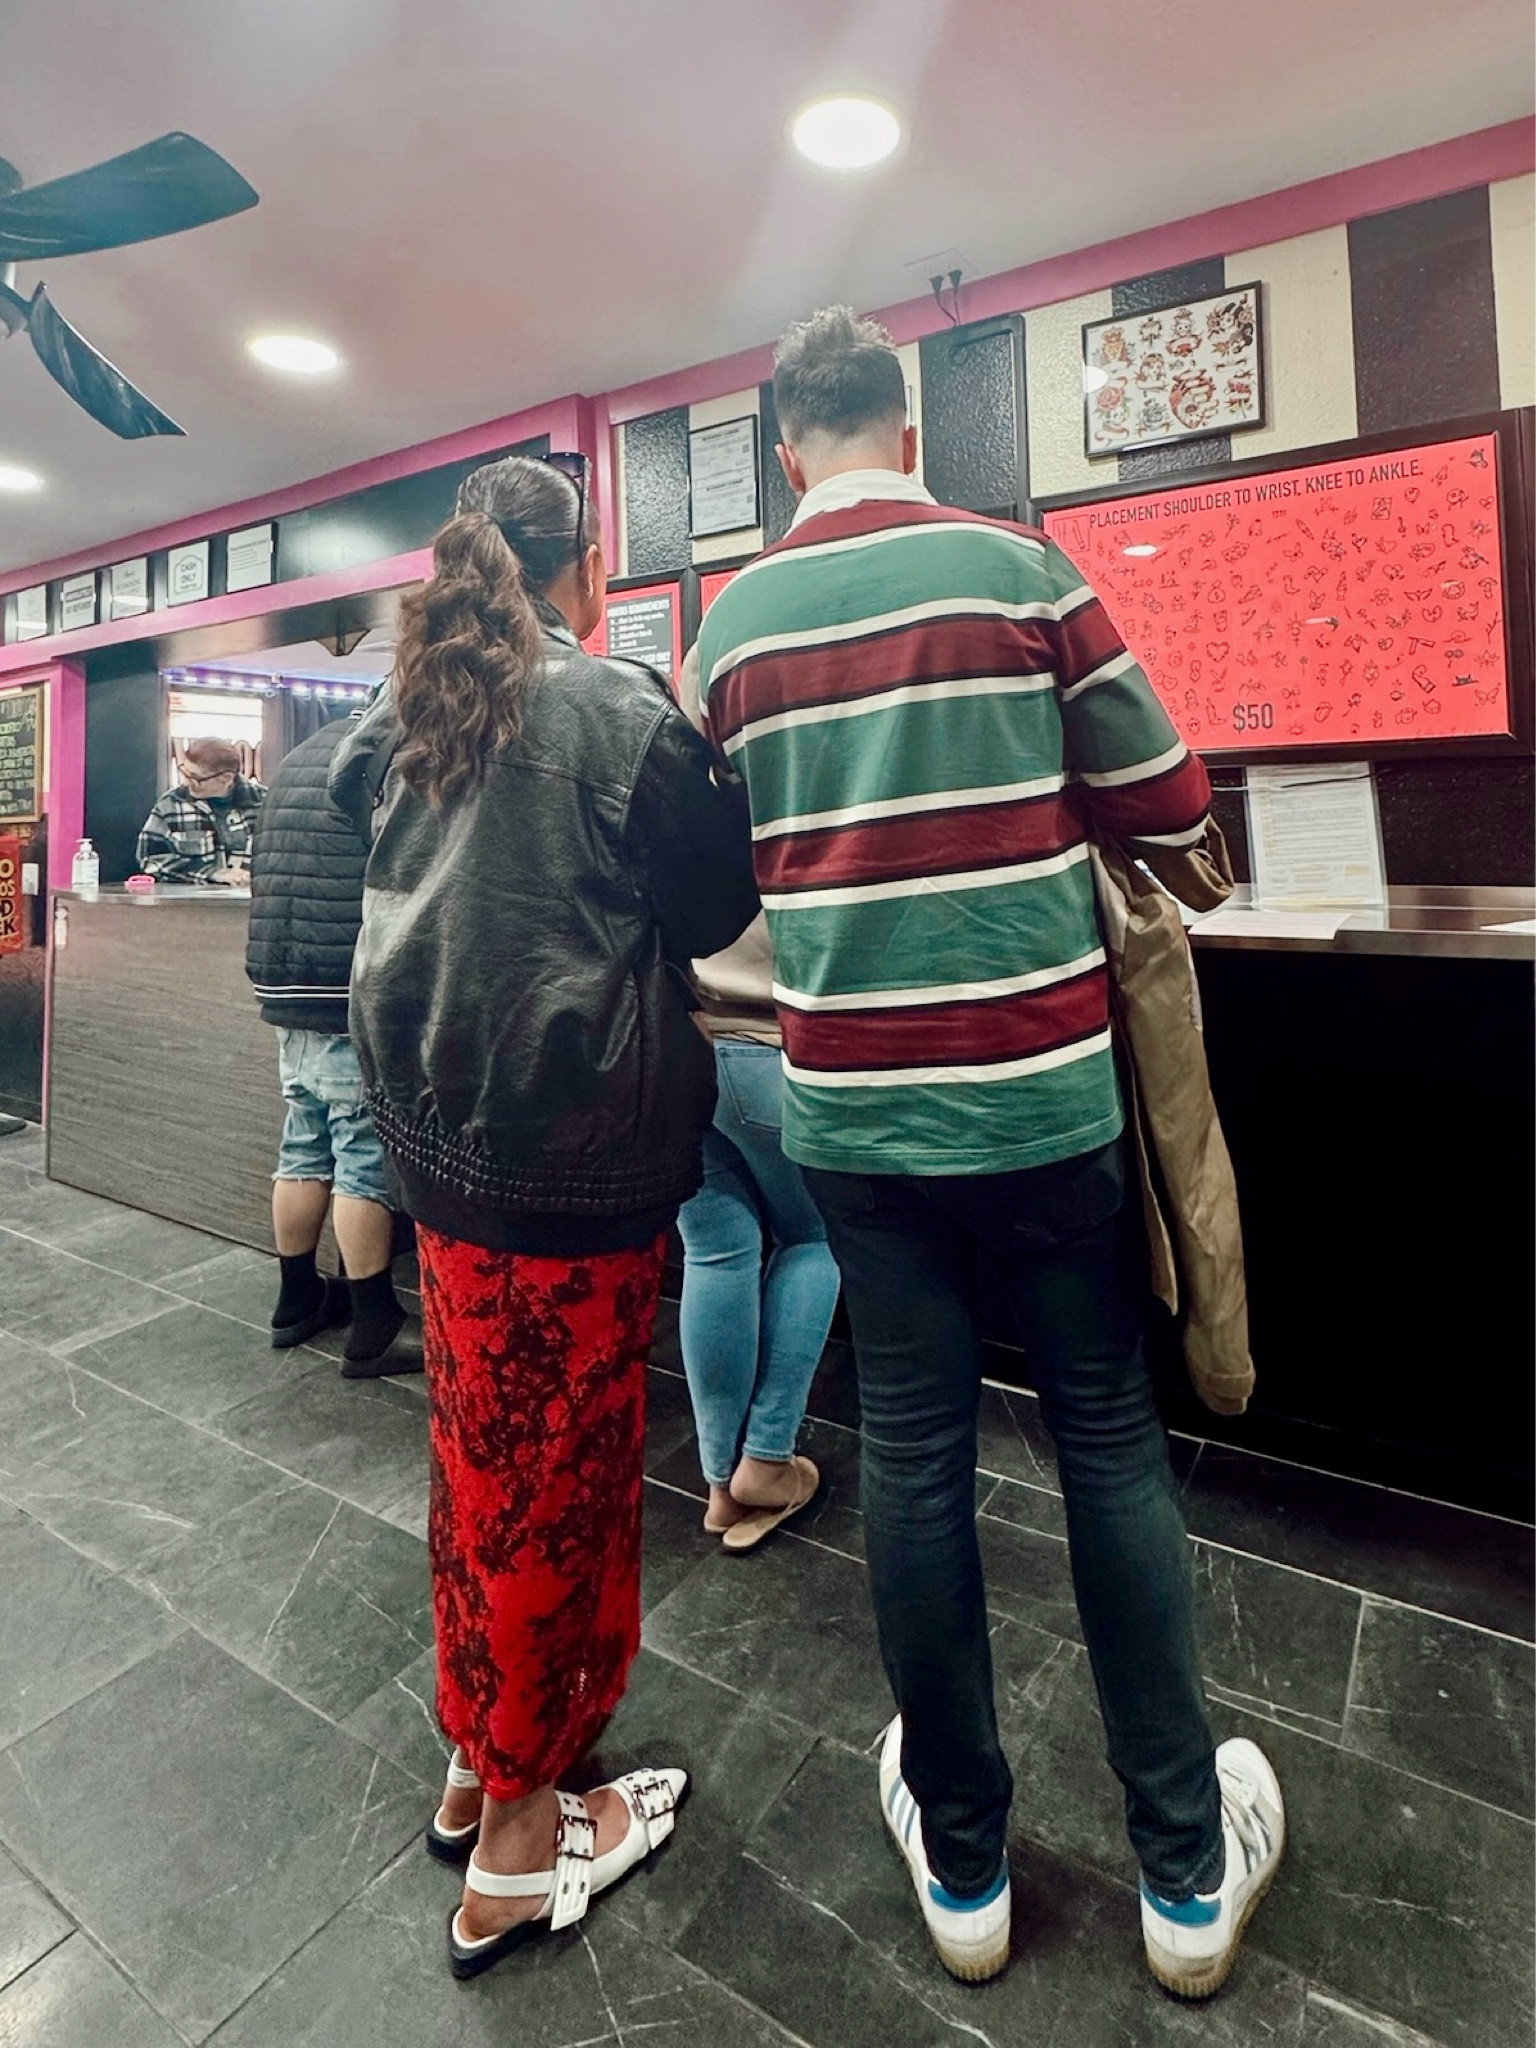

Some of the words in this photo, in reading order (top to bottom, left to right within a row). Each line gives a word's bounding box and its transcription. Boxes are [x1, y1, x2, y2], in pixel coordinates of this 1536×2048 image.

[1089, 503, 1160, 528] PLACEMENT
[1164, 492, 1231, 516] SHOULDER
[1235, 489, 1251, 505] TO
[1306, 472, 1343, 494] KNEE
[1347, 469, 1364, 486] TO
[1369, 459, 1423, 483] ANKLE.
[180, 561, 197, 572] CASH
[180, 573, 196, 583] ONLY
[1233, 702, 1273, 734] $50
